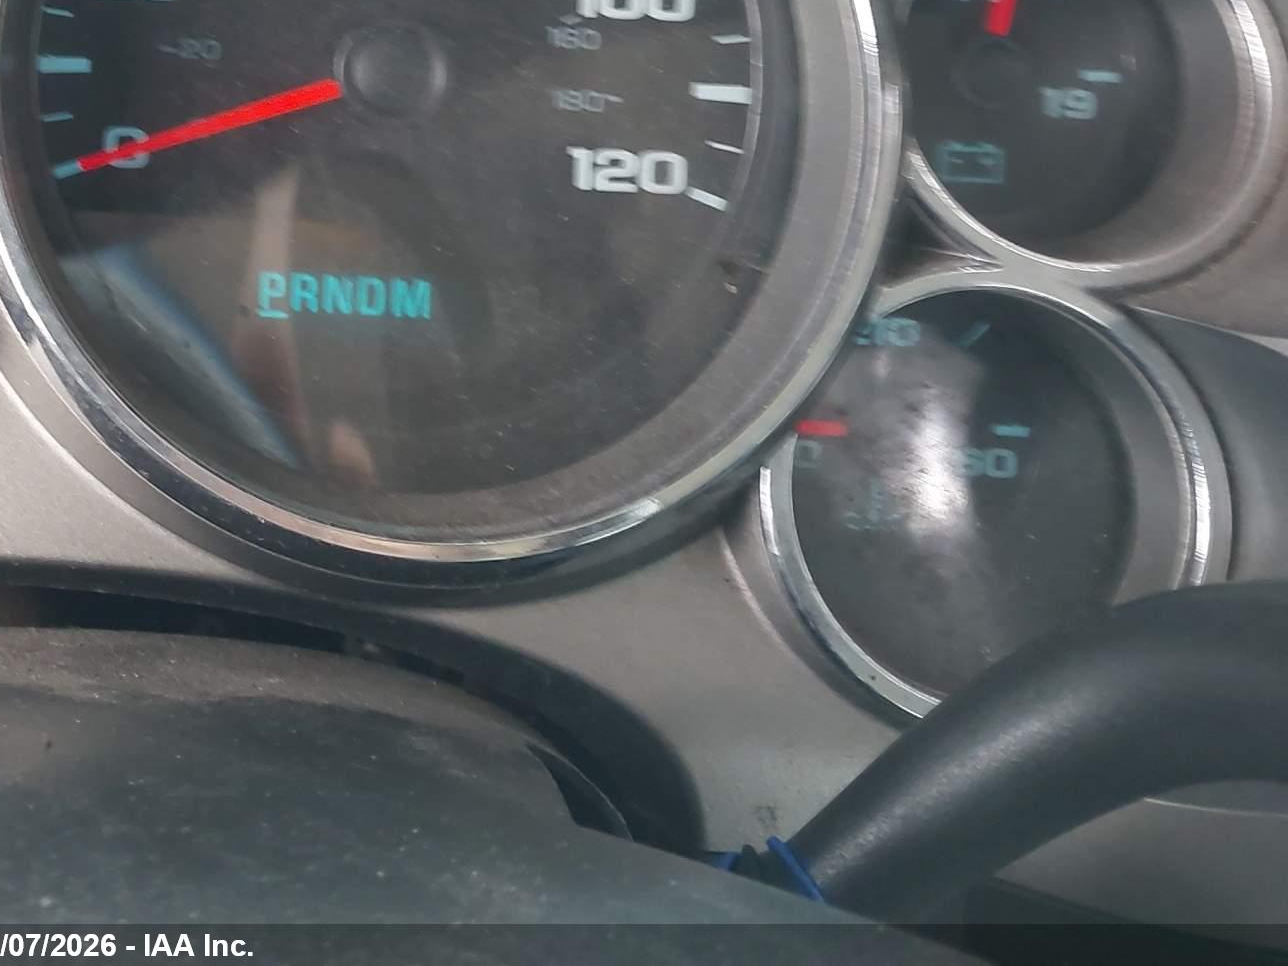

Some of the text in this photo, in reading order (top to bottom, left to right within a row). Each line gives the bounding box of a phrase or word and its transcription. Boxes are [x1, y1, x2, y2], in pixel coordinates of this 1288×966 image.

[546, 26, 602, 50] 160
[551, 88, 605, 113] 180
[1038, 86, 1097, 120] 19
[102, 125, 150, 169] 0
[566, 146, 688, 195] 120
[257, 271, 431, 320] PRNDM
